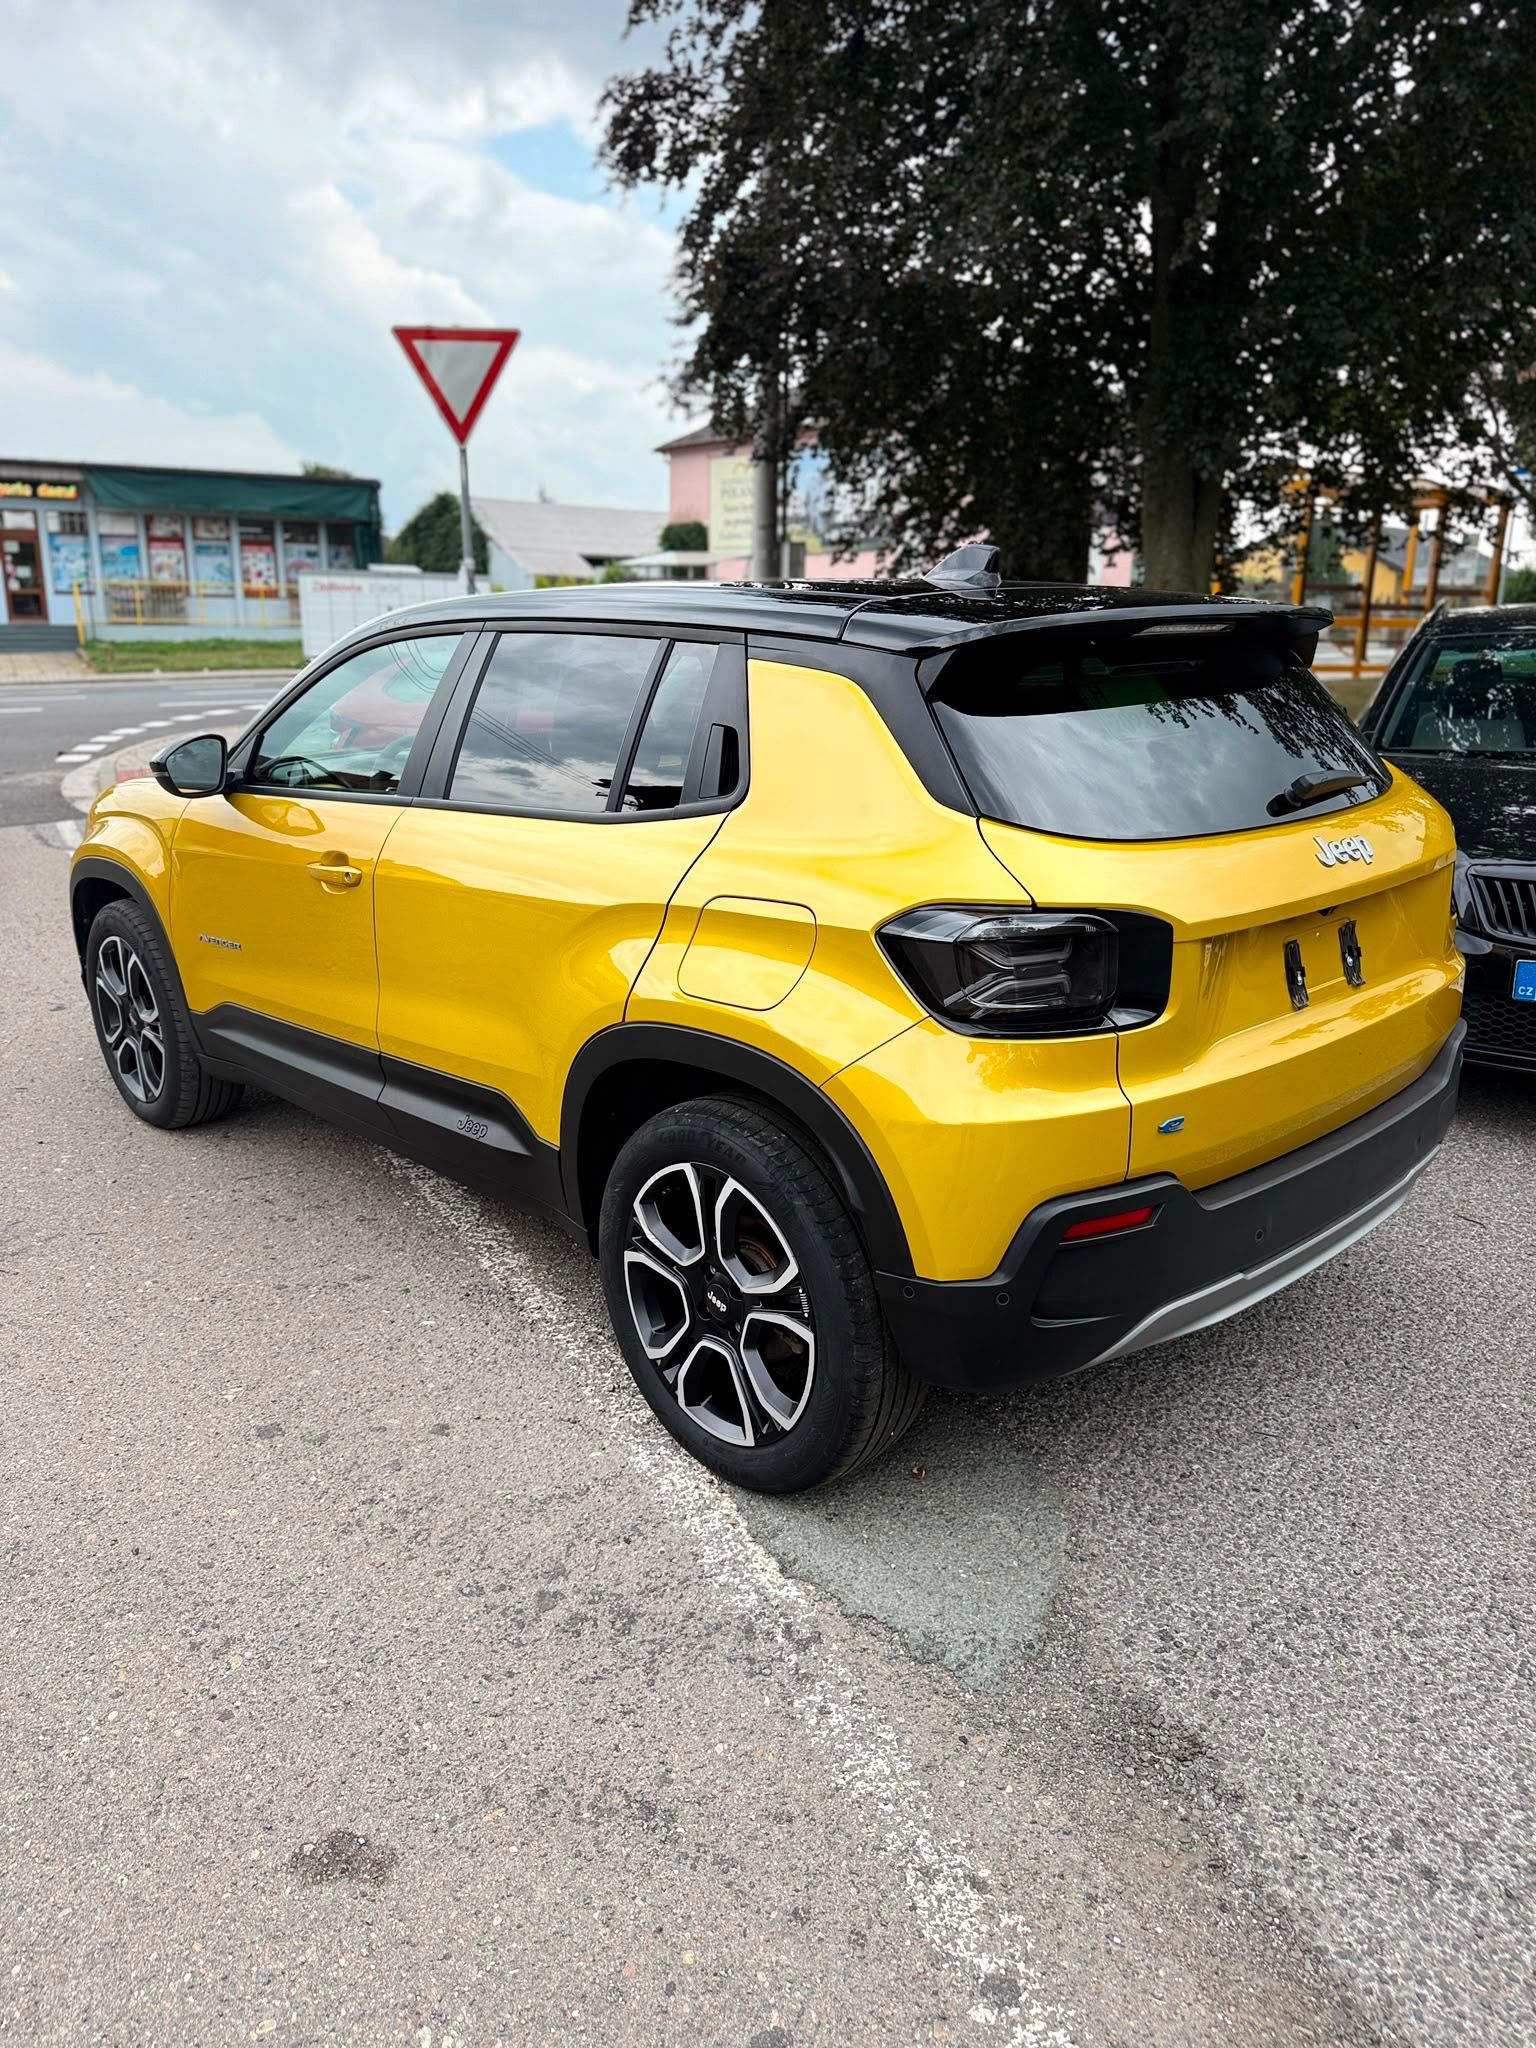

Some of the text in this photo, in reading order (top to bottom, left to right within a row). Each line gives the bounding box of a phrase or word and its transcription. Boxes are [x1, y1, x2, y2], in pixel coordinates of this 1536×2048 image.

[1313, 835, 1373, 867] Jeep
[1518, 986, 1534, 996] CZ
[457, 1114, 488, 1139] Jeep
[707, 1291, 726, 1312] Jeep
